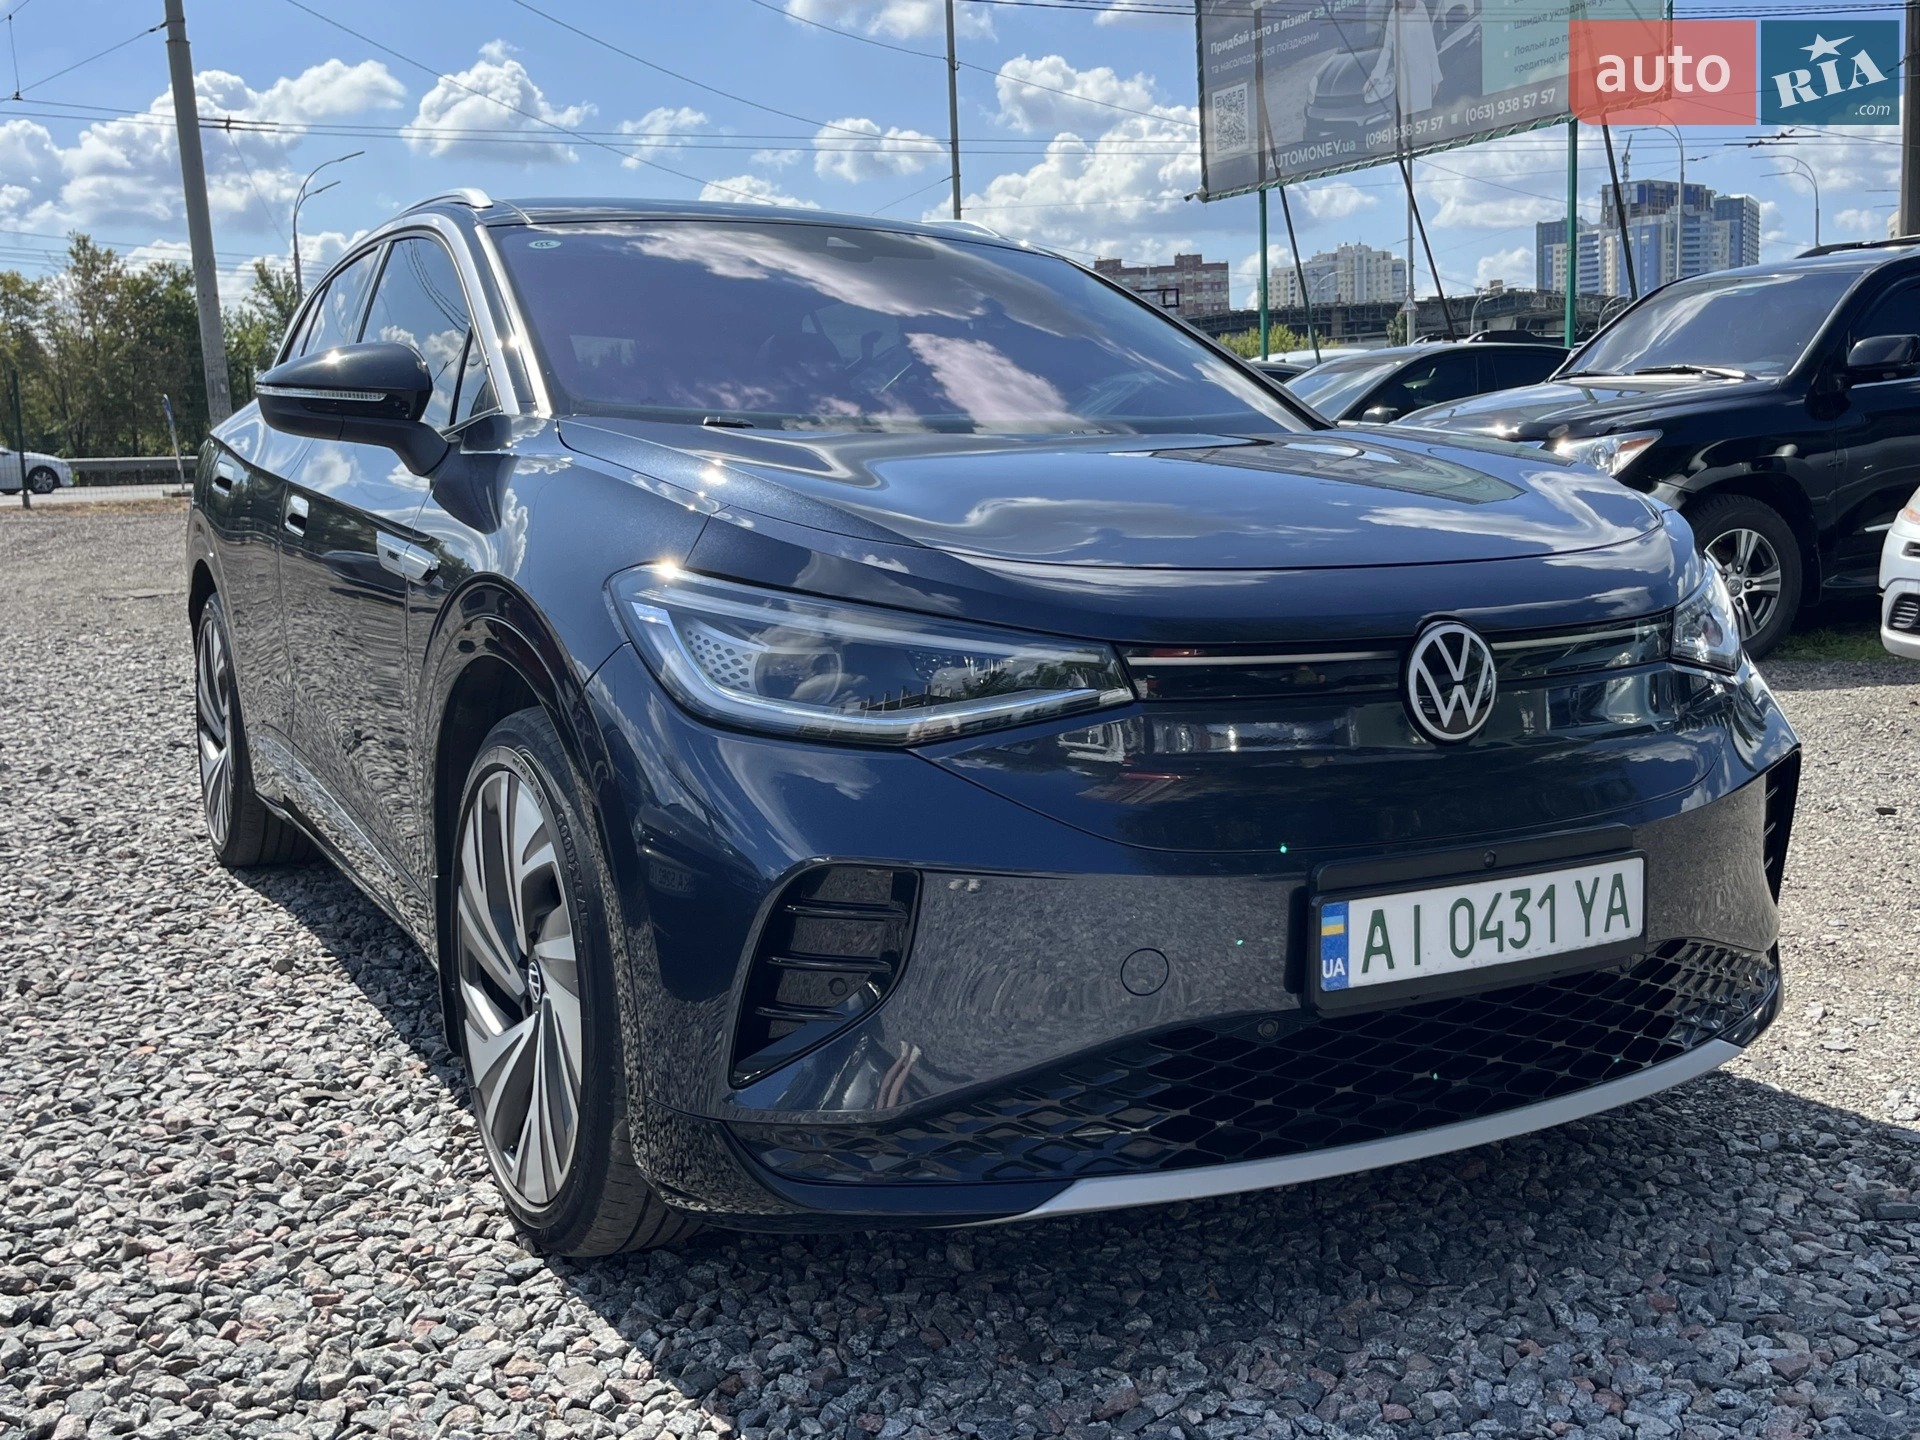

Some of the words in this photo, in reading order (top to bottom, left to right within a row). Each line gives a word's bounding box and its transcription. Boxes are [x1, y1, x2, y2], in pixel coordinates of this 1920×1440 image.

[1210, 30, 1249, 55] Придбай
[1250, 25, 1272, 41] авто
[1273, 23, 1280, 33] в
[1281, 10, 1313, 31] лізинг
[1314, 6, 1326, 19] за
[1513, 13, 1548, 30] Швидке
[1549, 0, 1597, 21] укладання
[1211, 65, 1219, 75] та
[1220, 46, 1276, 71] насолоджуйся
[1276, 31, 1320, 54] поїздками
[1513, 37, 1548, 56] Лояльні
[1548, 35, 1560, 48] до
[1513, 53, 1558, 74] кредитної
[1266, 140, 1357, 172] AUTOMONEY.ua
[1365, 128, 1391, 149] (096)
[1393, 122, 1413, 141] 938
[1414, 118, 1428, 135] 57
[1430, 116, 1444, 131] 57
[1464, 102, 1496, 126] (063)
[1496, 97, 1521, 117] 938
[1522, 92, 1539, 111] 57
[1539, 87, 1556, 105] 57
[1361, 903, 1421, 974] AI
[1449, 884, 1556, 959] 0431
[1575, 872, 1631, 937] YA
[1322, 959, 1346, 979] UA
